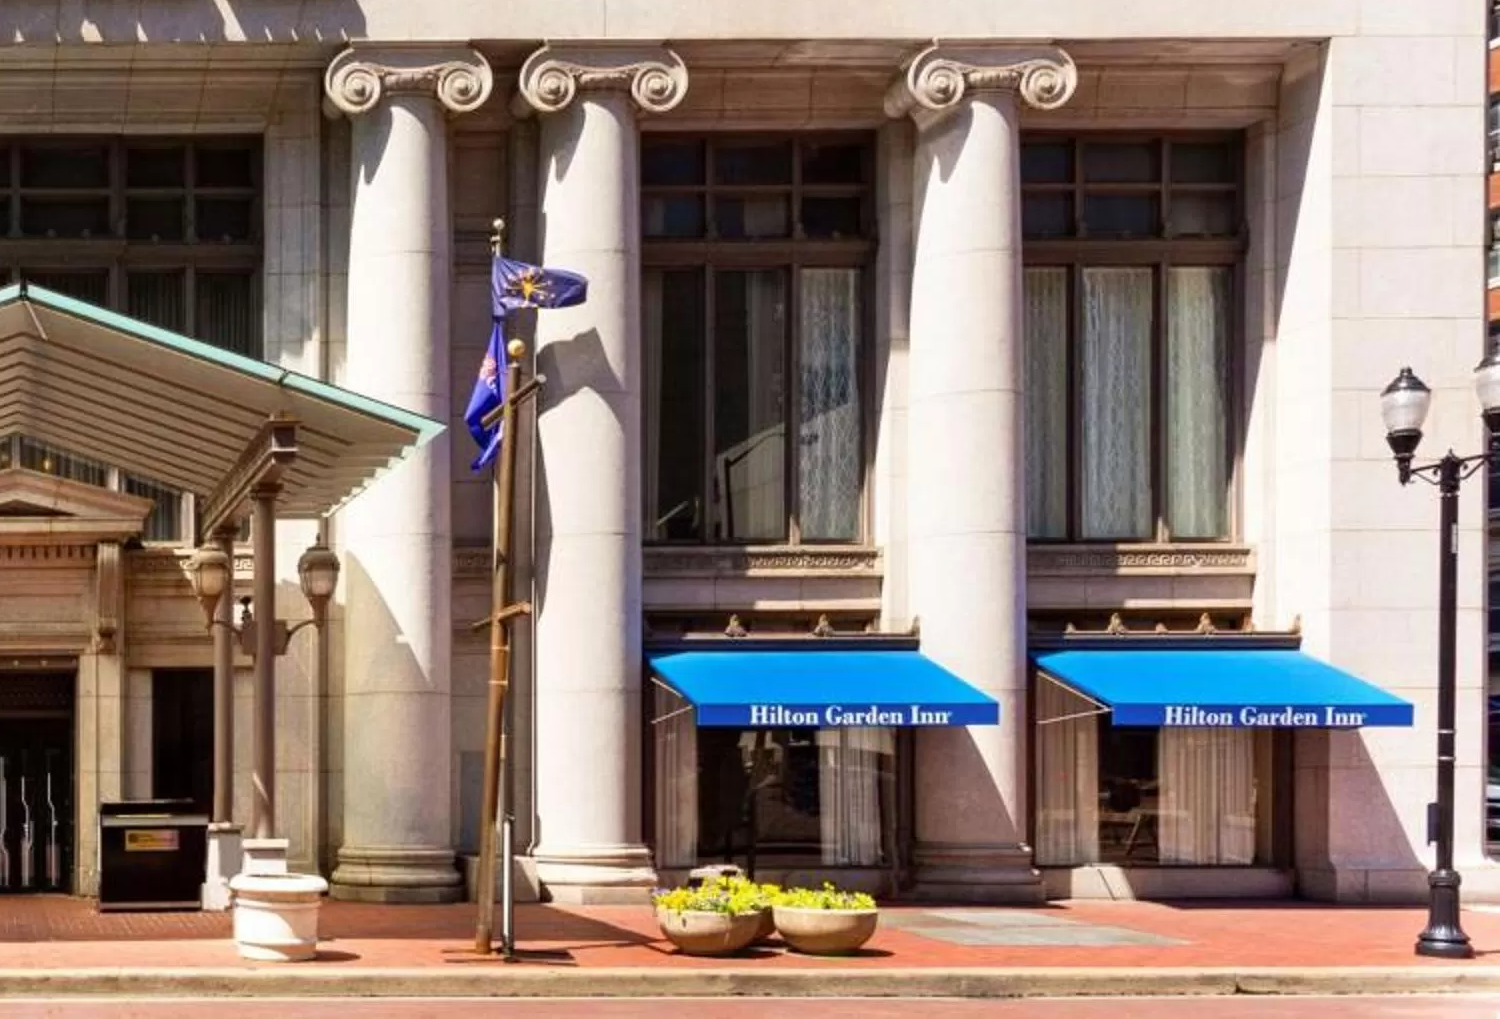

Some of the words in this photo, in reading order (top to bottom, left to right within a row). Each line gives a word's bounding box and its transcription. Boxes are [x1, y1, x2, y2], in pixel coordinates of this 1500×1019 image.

[750, 704, 819, 726] Hilton
[825, 705, 902, 726] Garden
[911, 705, 949, 725] Inn
[1164, 706, 1233, 727] Hilton
[1239, 706, 1318, 727] Garden
[1325, 707, 1364, 726] Inn
